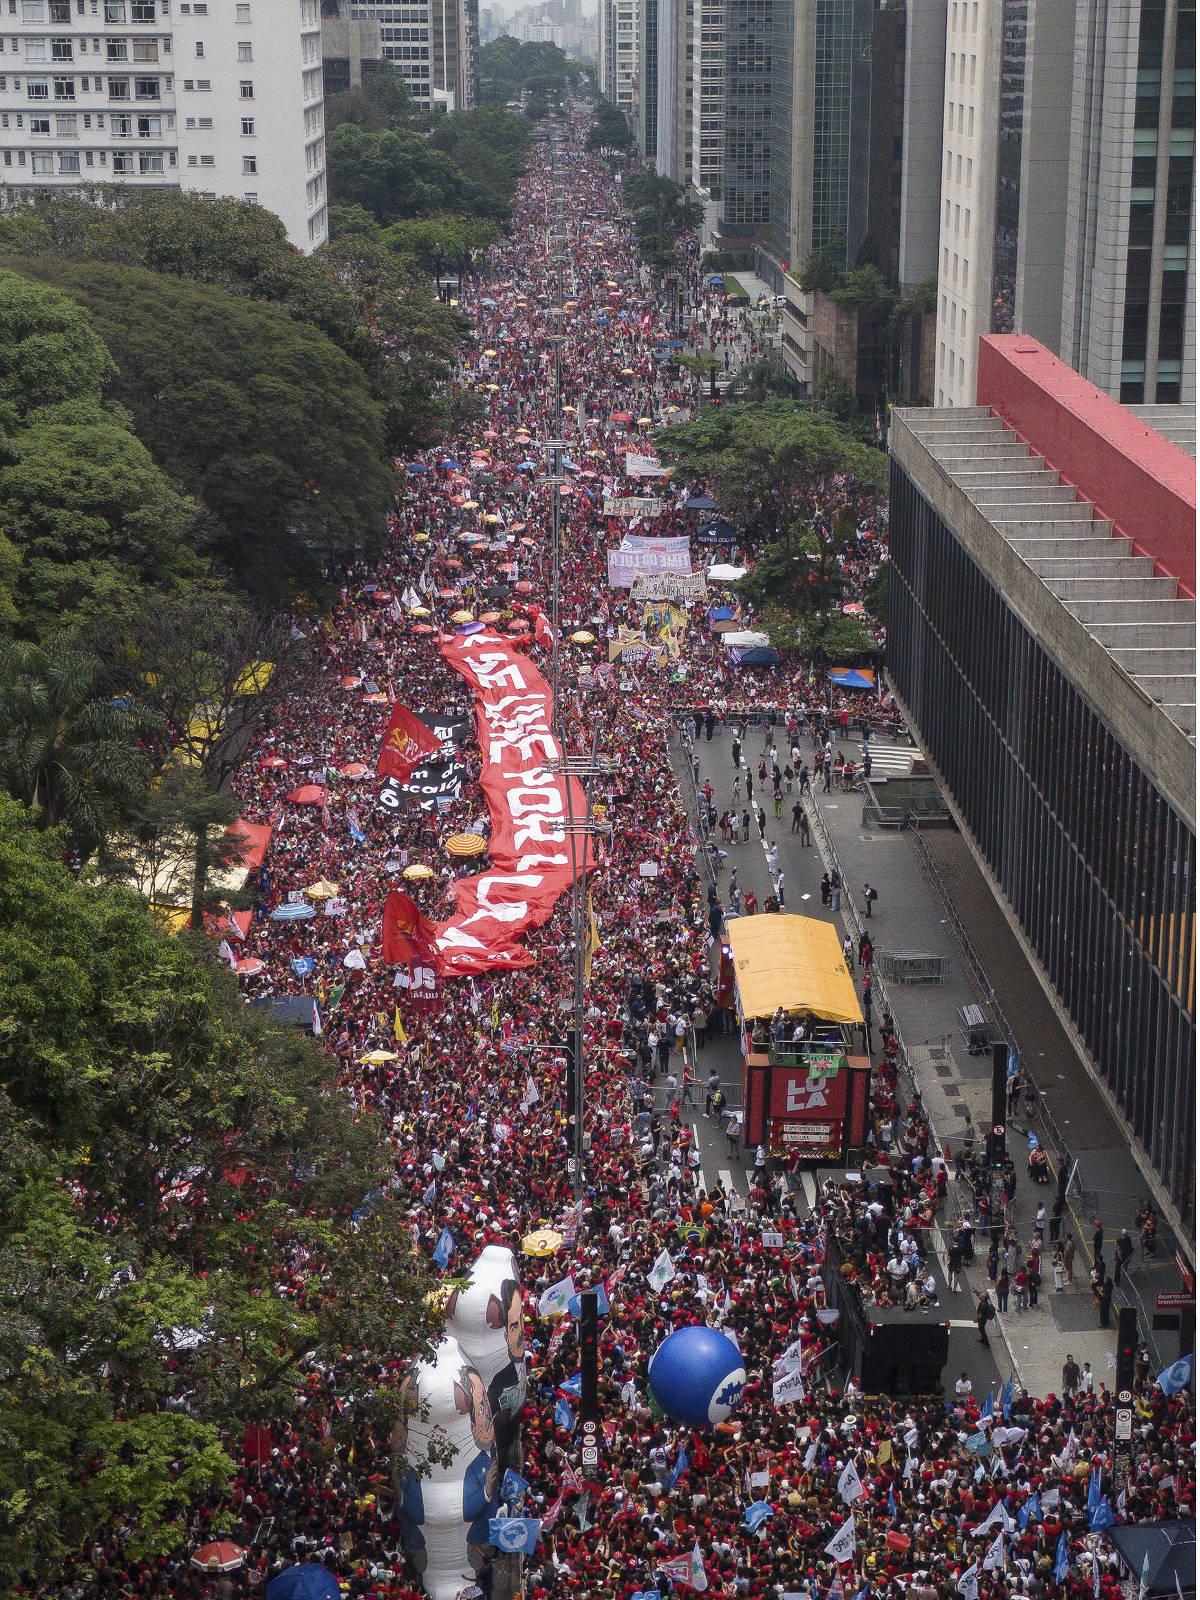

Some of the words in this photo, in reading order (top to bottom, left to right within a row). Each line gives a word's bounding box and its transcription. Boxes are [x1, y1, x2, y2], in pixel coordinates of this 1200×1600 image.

[379, 788, 399, 807] 6
[502, 767, 566, 852] POR
[787, 1077, 826, 1096] LU
[786, 1091, 828, 1112] LA
